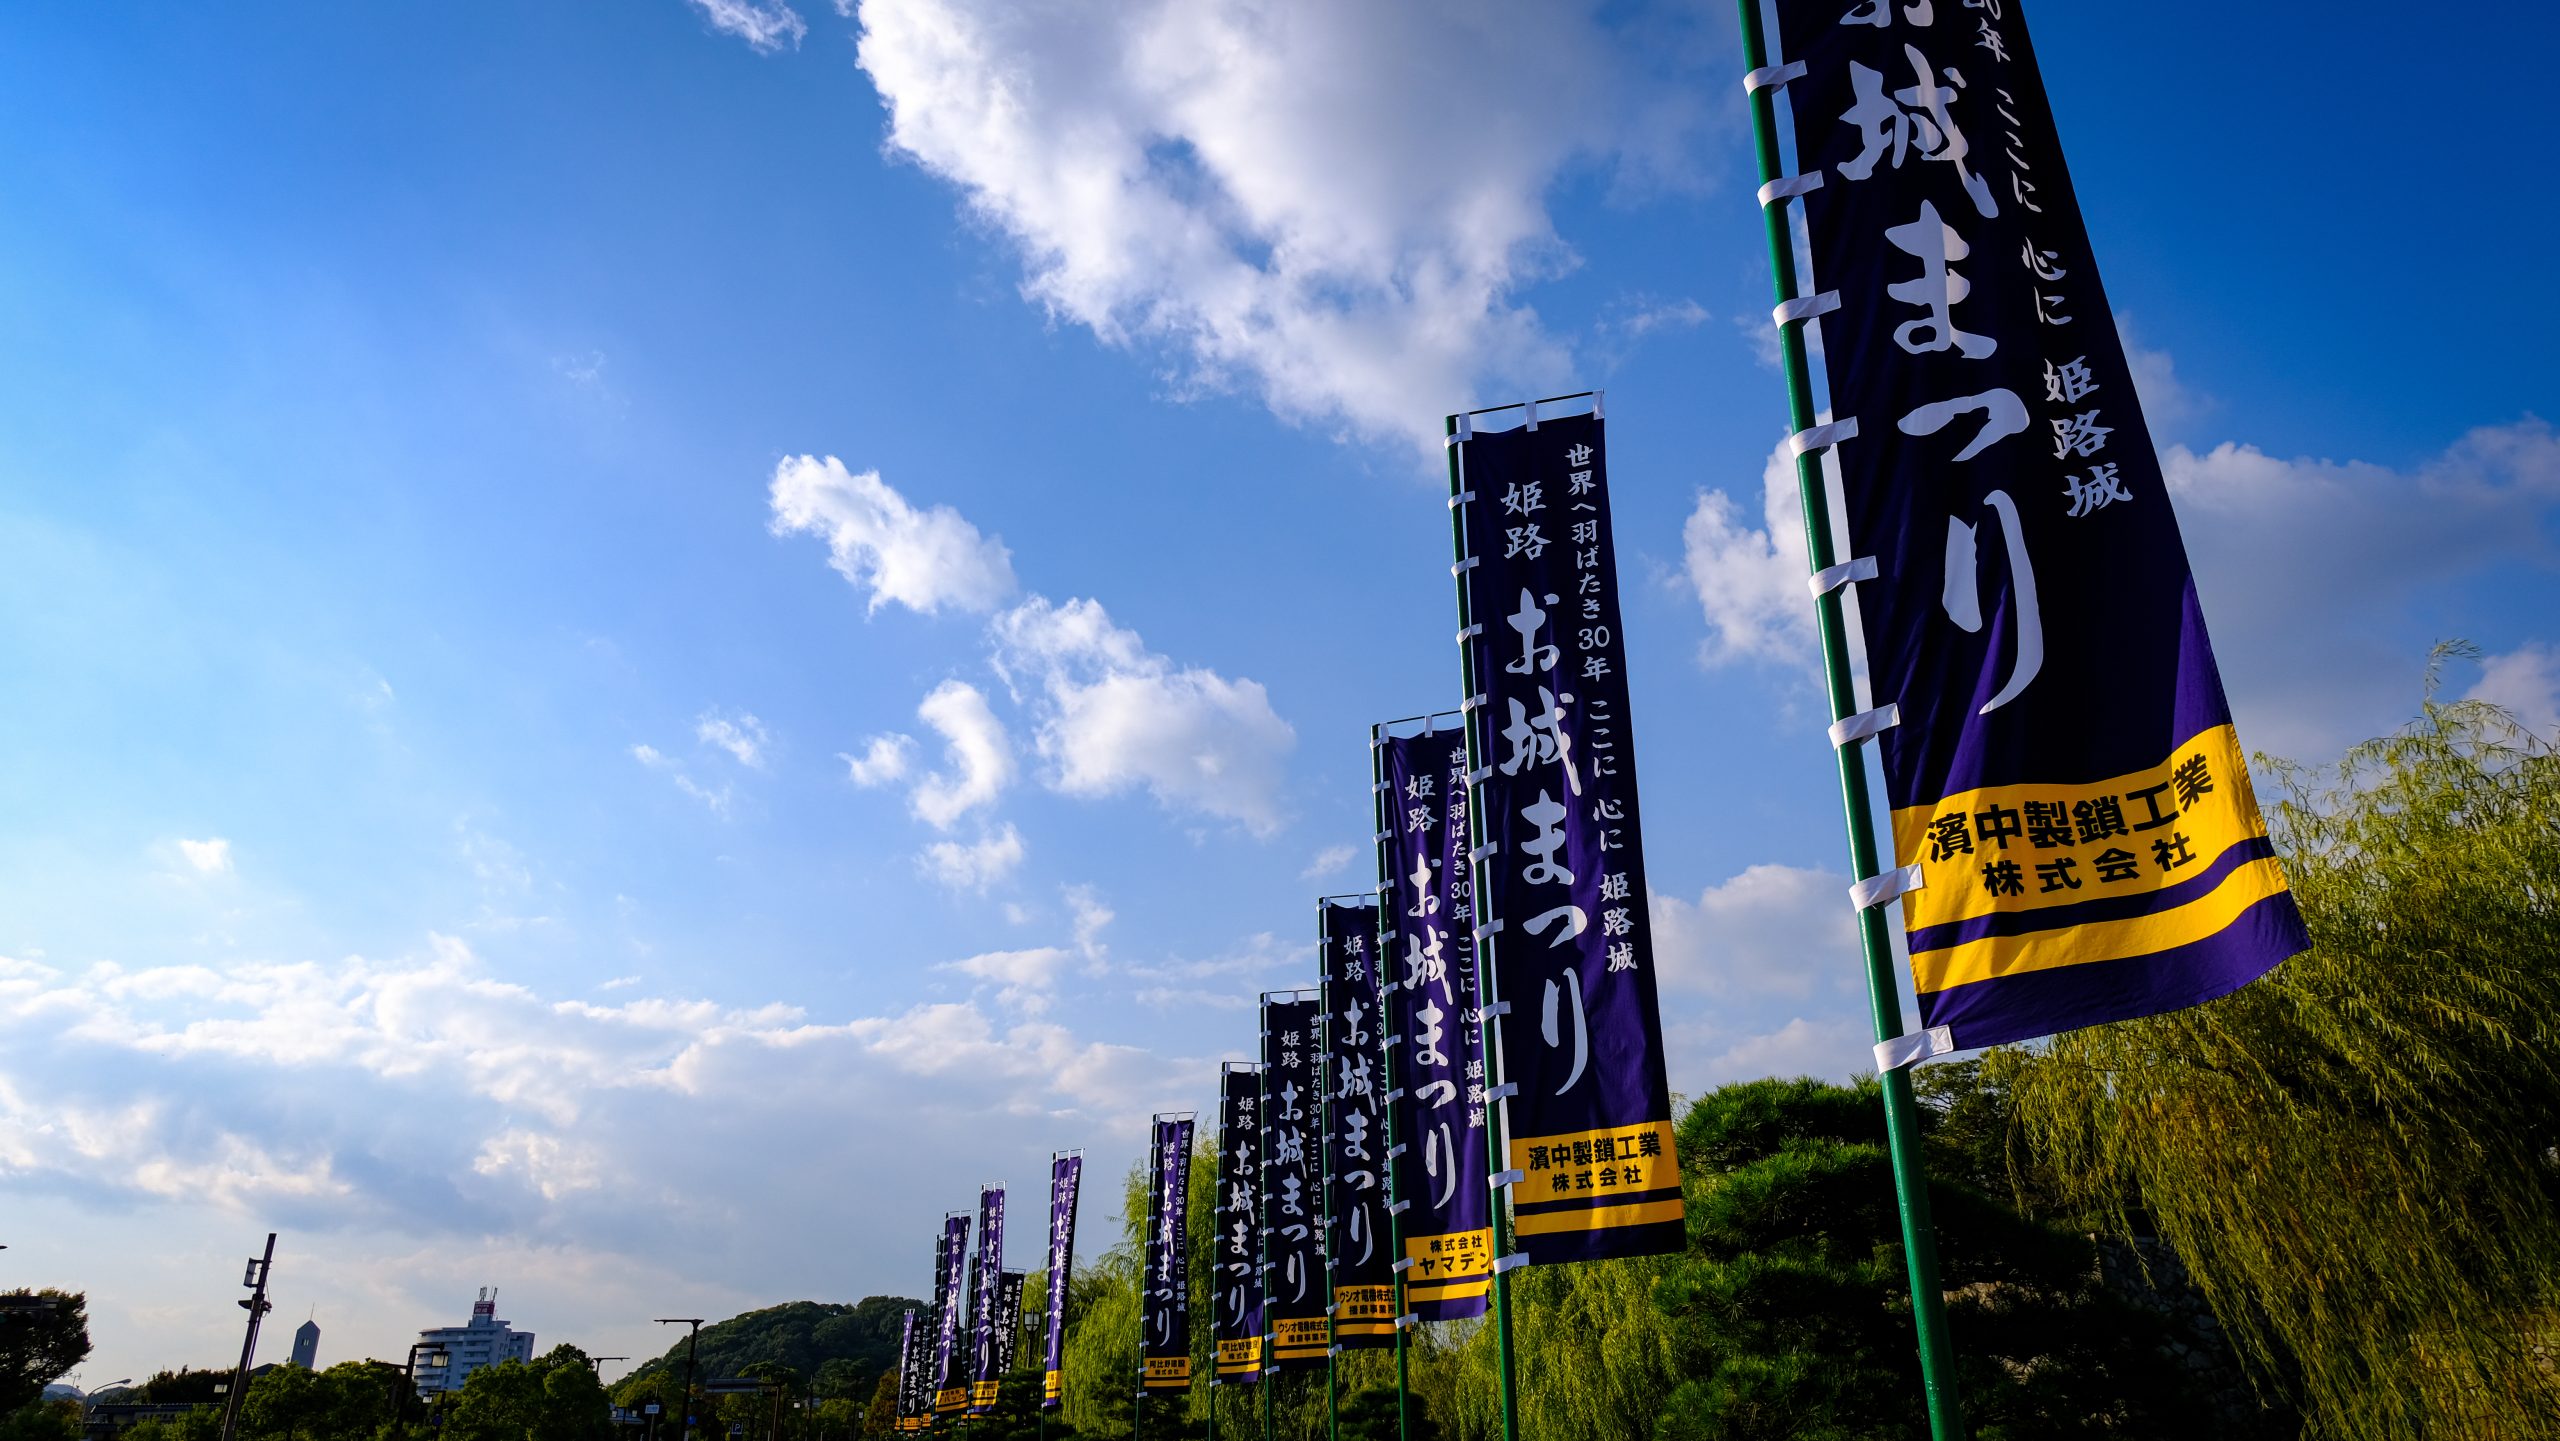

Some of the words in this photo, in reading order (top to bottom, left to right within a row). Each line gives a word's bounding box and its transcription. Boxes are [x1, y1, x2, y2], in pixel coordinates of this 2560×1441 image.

[1996, 88, 2042, 213] ここに
[2021, 236, 2073, 326] 心に
[2043, 355, 2134, 518] 姫路城
[1500, 480, 1552, 561] 姫路
[1565, 443, 1611, 682] 世界へ羽ばたき30年
[1589, 699, 1618, 777] ここに
[1404, 774, 1439, 834] 姫路
[1592, 798, 1625, 851] 心に
[1926, 753, 2214, 864] 濱中製鎖工業
[1499, 587, 1588, 1096] お城まつり
[1981, 833, 2197, 898] 株式会社
[1598, 872, 1638, 973] 姫路城
[1343, 934, 1366, 982] 姫路
[1458, 936, 1476, 993] ここに
[1281, 1030, 1302, 1069] 姫路
[1402, 852, 1457, 1210] お城まつり
[1461, 1006, 1481, 1045] 心に
[1237, 1096, 1255, 1131] 姫路
[1465, 1060, 1485, 1129] 姫路城
[1310, 1137, 1319, 1173] ここに
[1337, 996, 1377, 1267] お城まつり
[1528, 1131, 1662, 1171] 濱中製鎖工業
[1275, 1079, 1309, 1304] お城まつり
[1310, 1181, 1321, 1206] 心に
[1551, 1164, 1643, 1192] 株式会社
[1154, 1180, 1175, 1346] お城まつり
[1228, 1140, 1256, 1327] お城まつり
[1313, 1213, 1327, 1256] 姫路城
[1419, 1251, 1488, 1275] ヤマデン
[1430, 1235, 1482, 1253] 株式会社
